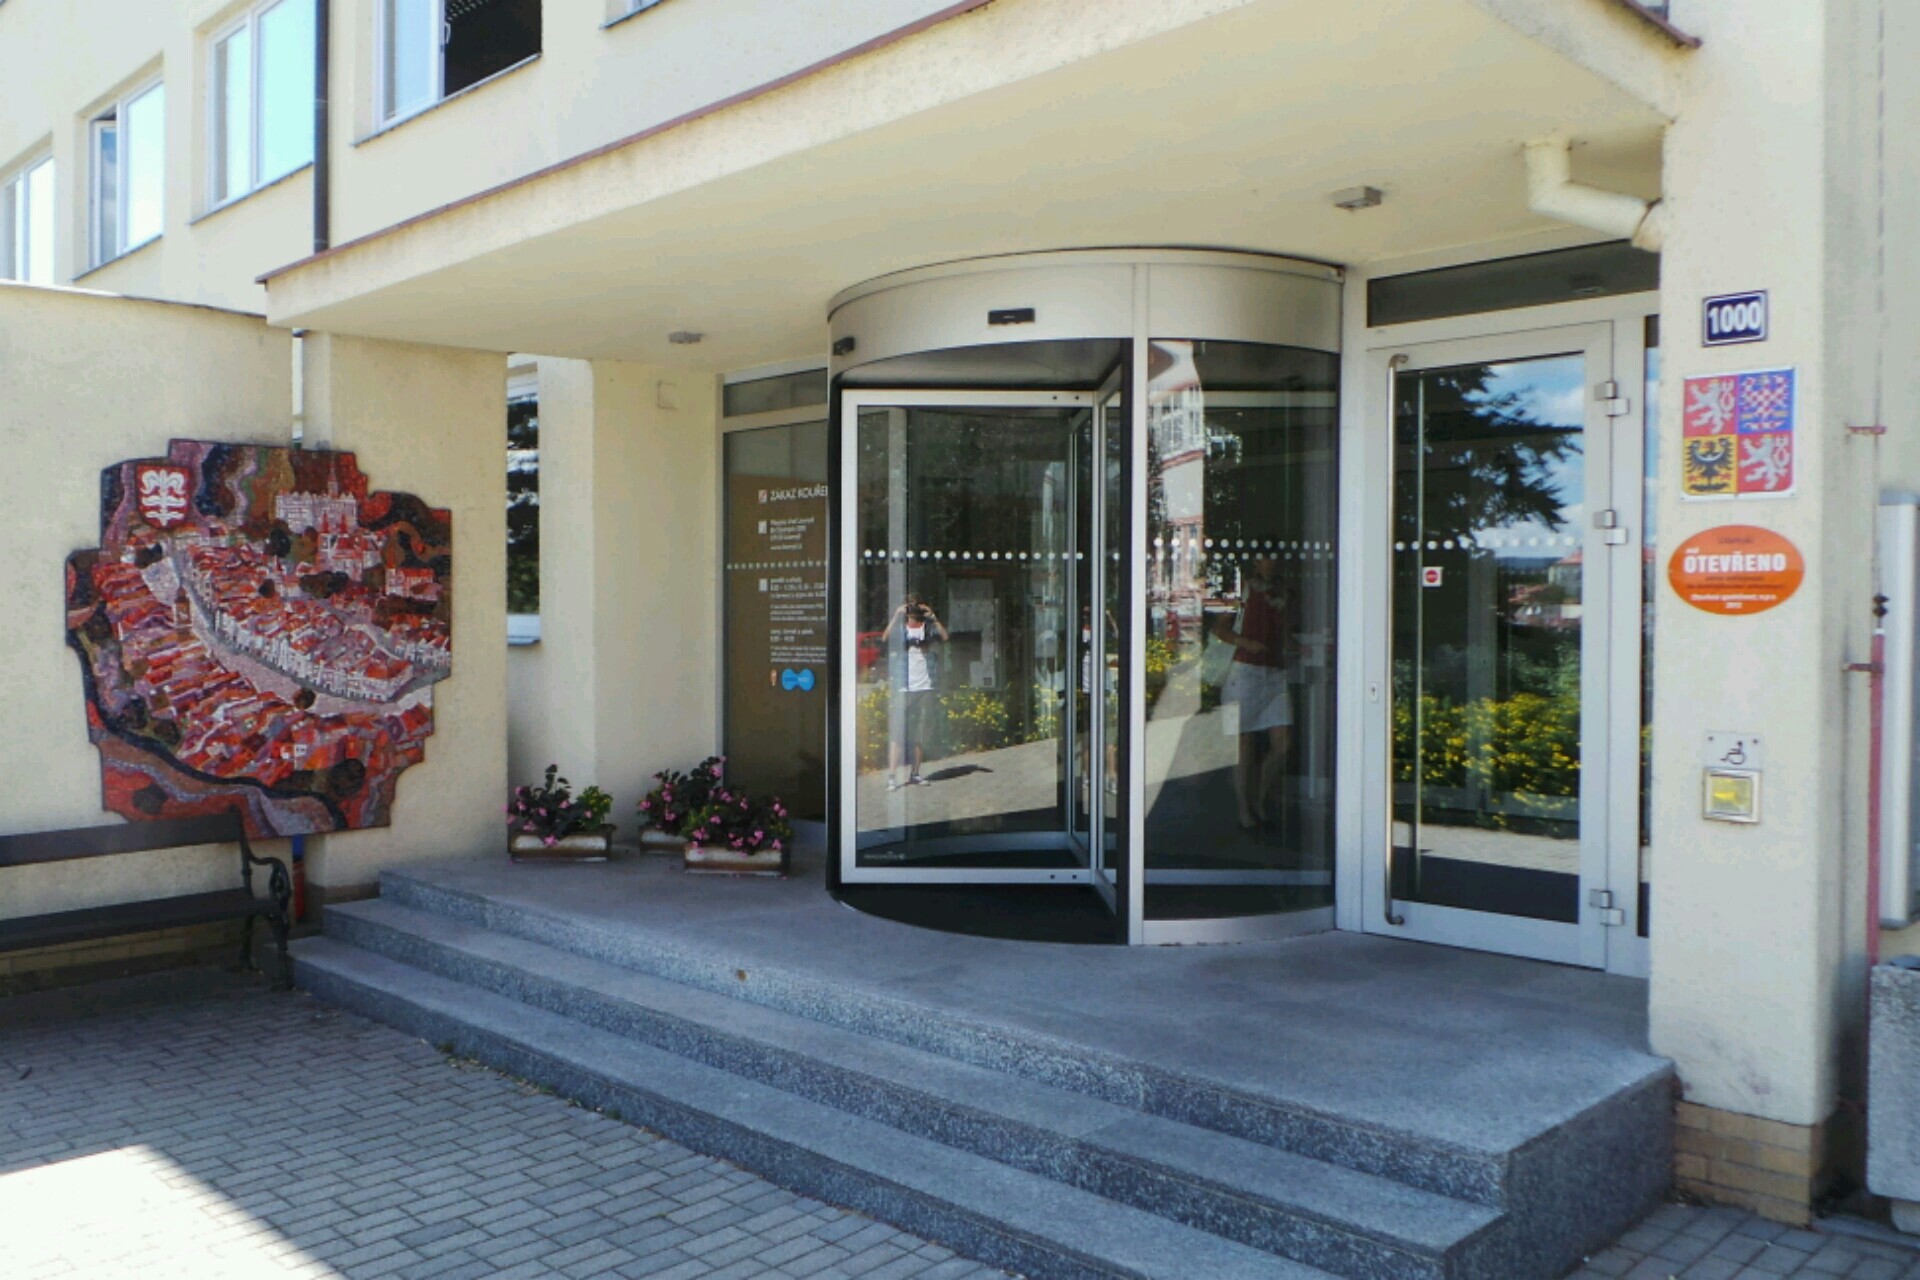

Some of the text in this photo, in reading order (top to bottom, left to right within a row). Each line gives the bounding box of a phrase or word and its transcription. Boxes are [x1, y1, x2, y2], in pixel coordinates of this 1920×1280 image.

[1708, 301, 1762, 335] 1000
[797, 483, 828, 499] KOUŘE
[1684, 551, 1786, 573] OTEVŘENO
